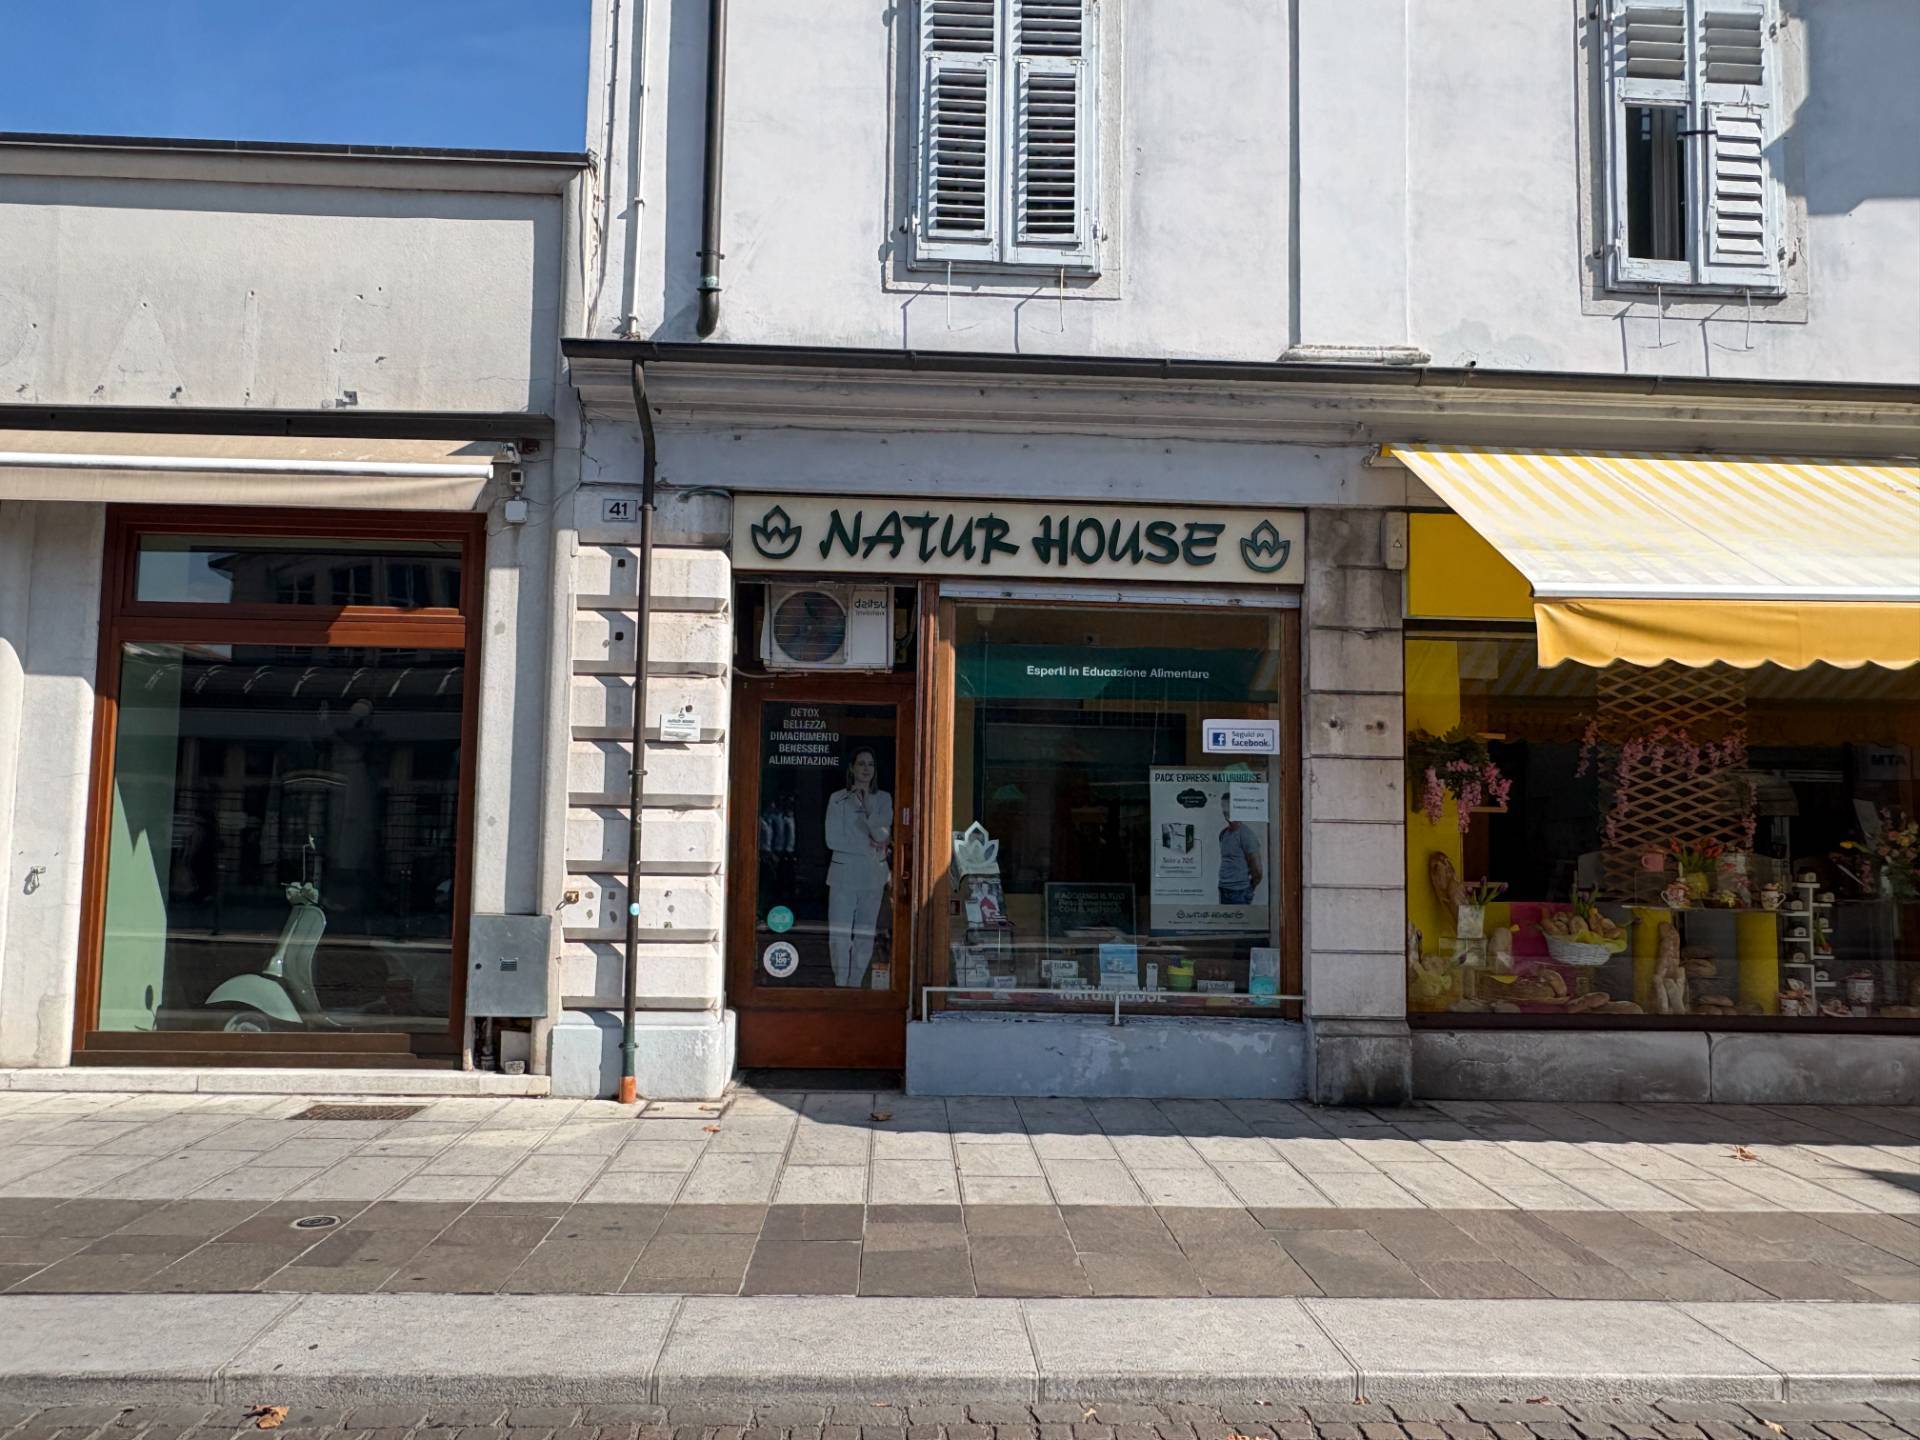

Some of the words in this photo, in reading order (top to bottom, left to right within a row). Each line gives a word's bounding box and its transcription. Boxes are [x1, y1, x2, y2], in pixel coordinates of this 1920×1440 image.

[609, 502, 627, 516] 41
[819, 508, 1020, 565] NATUR
[1032, 513, 1226, 568] HOUSE
[1026, 665, 1066, 677] Esperti
[1069, 666, 1079, 676] in
[1083, 666, 1147, 678] Educazione
[1150, 668, 1210, 679] Alimentare
[791, 708, 820, 718] DETOX
[783, 719, 827, 730] BELLEZZA
[769, 731, 840, 742] DIMAGRIMENTO
[779, 743, 830, 753] BENESSERE
[768, 755, 841, 766] ALIMENTAZIONE
[1176, 773, 1210, 783] EXPRESS
